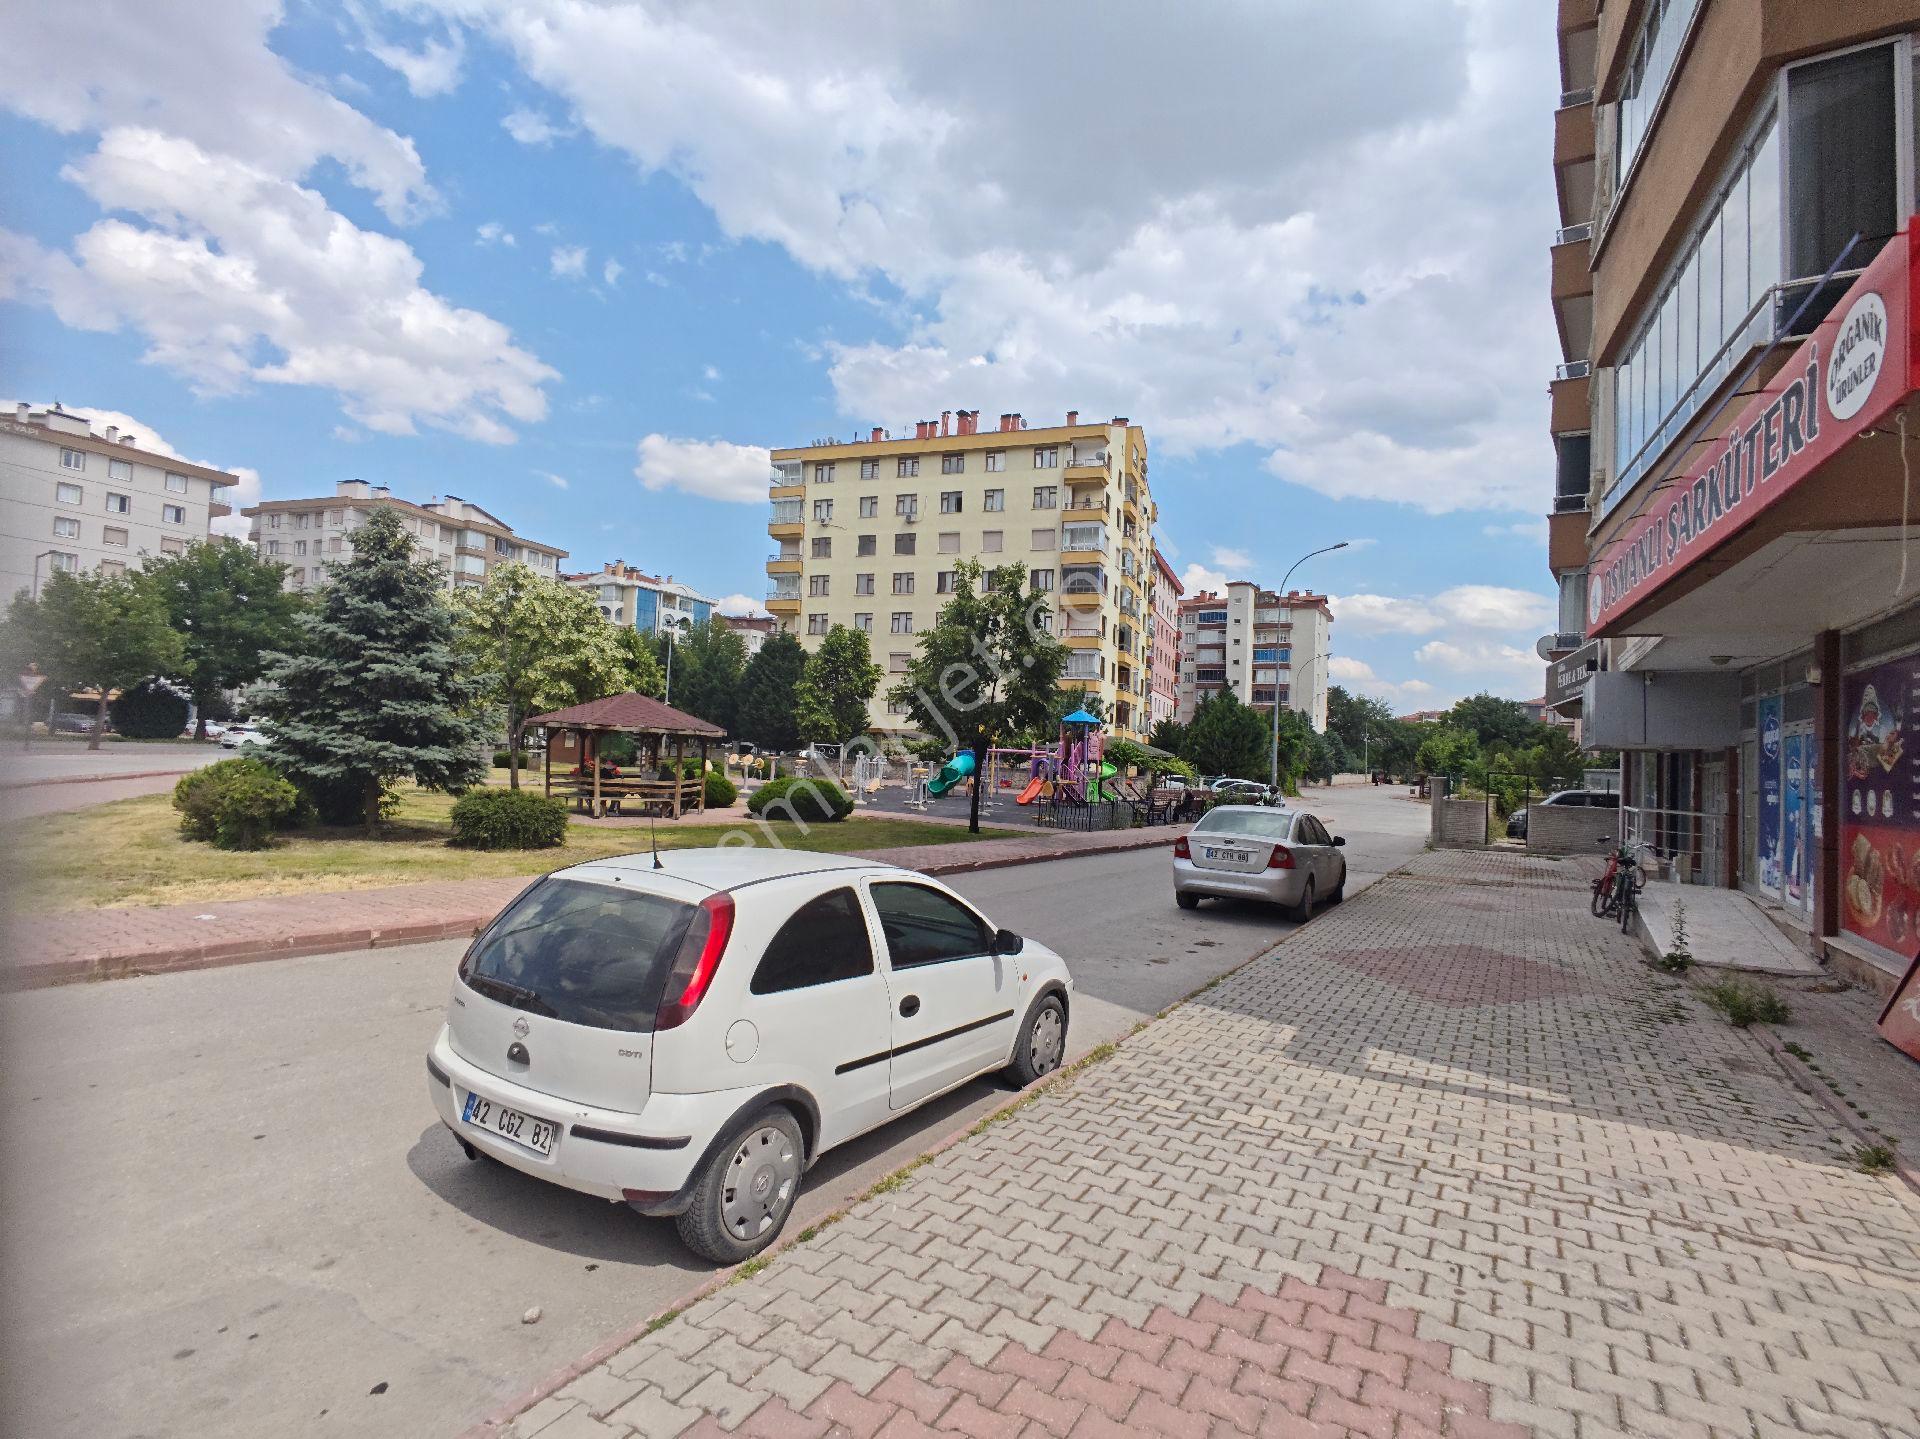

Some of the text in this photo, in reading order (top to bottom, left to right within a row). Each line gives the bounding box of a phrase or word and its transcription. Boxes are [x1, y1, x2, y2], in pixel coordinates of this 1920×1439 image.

[1829, 303, 1882, 391] ORGANİK
[1835, 351, 1876, 405] ÜRÜNLER
[1602, 340, 1820, 611] OSMANLI ŞARKÜTERİ
[471, 1099, 550, 1150] 42 CGZ 82
